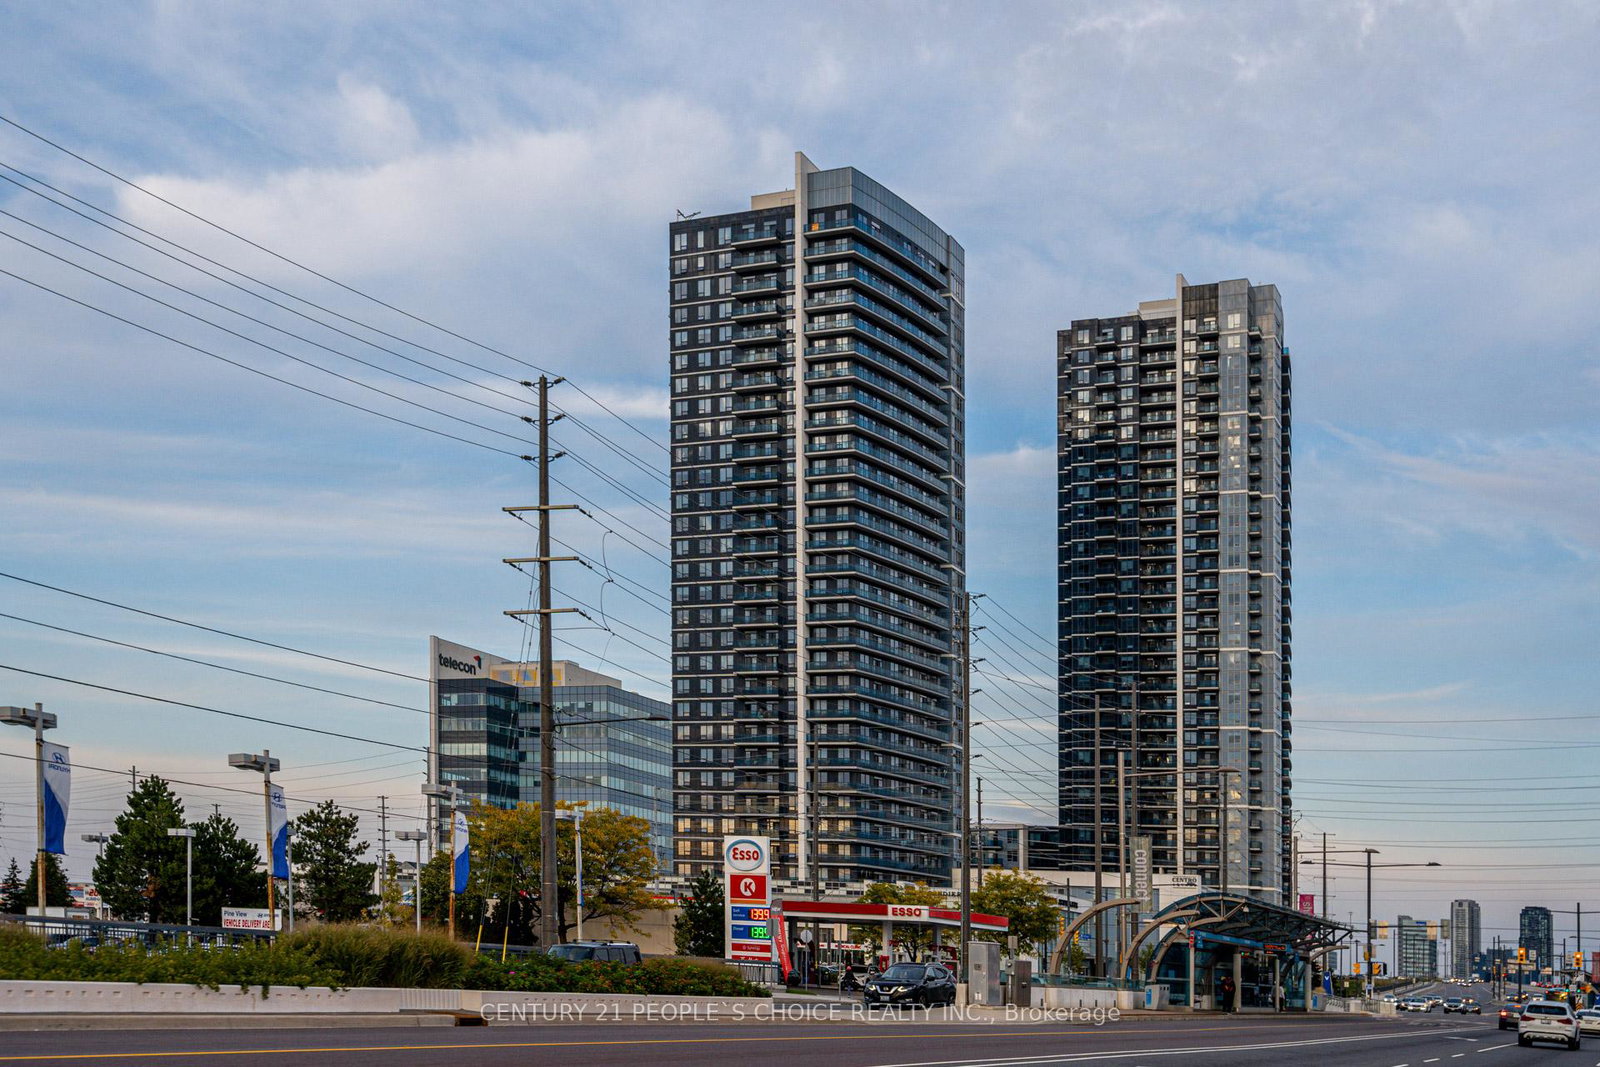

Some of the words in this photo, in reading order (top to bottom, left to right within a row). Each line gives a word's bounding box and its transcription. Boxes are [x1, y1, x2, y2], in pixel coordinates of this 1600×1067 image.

[439, 653, 476, 675] telecon
[732, 847, 759, 861] Esso
[1135, 849, 1151, 902] connect
[235, 910, 247, 918] View
[891, 907, 921, 917] ESSO
[223, 918, 241, 928] VEHICLE
[242, 919, 262, 928] DELIVERY
[262, 920, 271, 929] ARE
